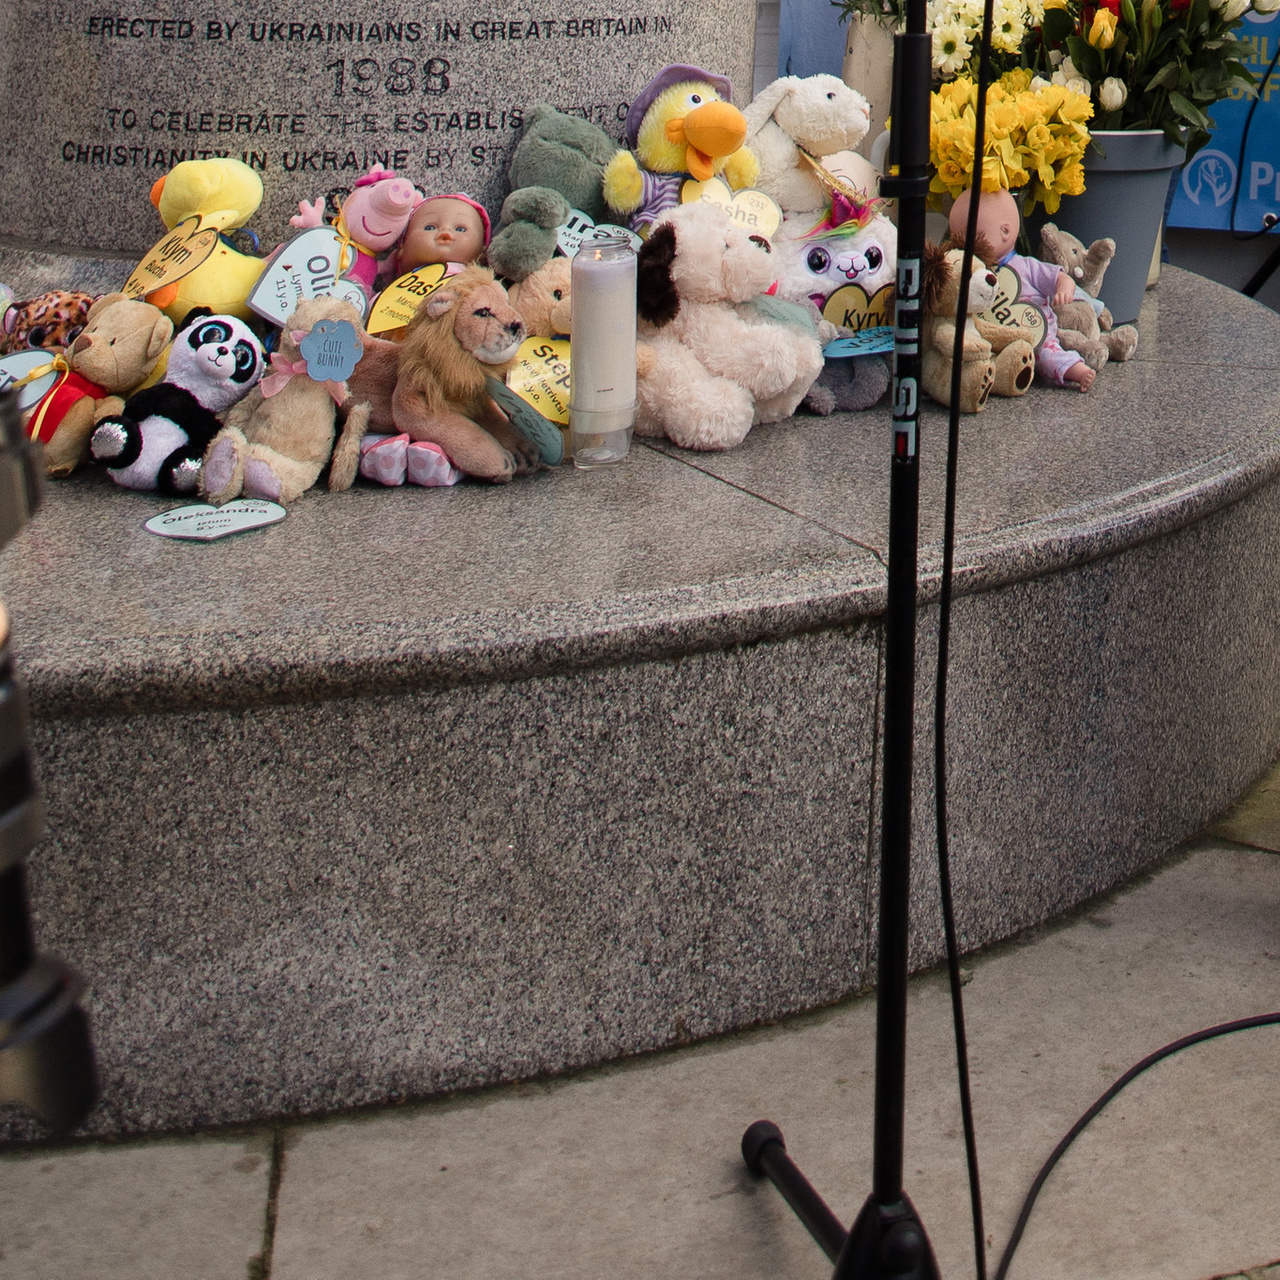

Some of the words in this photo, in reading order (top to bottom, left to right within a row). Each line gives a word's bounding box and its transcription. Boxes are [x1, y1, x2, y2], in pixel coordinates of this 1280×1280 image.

[87, 16, 194, 40] ERECTED
[206, 21, 239, 41] BY
[250, 21, 422, 42] UKRAINIANS
[435, 22, 461, 41] IN
[470, 20, 556, 41] GREAT
[566, 16, 648, 39] BRITAIN
[655, 15, 672, 33] IN
[326, 58, 451, 97] 1988
[106, 108, 137, 129] TO
[150, 110, 306, 134] CELEBRATE
[323, 113, 379, 134] THE
[242, 150, 268, 170] IN
[282, 149, 409, 172] UKRAINE
[425, 148, 456, 168] BY
[749, 198, 765, 210] 231
[159, 235, 193, 266] Klym
[144, 259, 168, 280] Bucha
[276, 293, 288, 312] y.o.
[1025, 311, 1038, 326] 458
[323, 339, 343, 354] CUTE
[317, 352, 345, 368] BUNNY
[162, 506, 268, 525] Oleksandra
